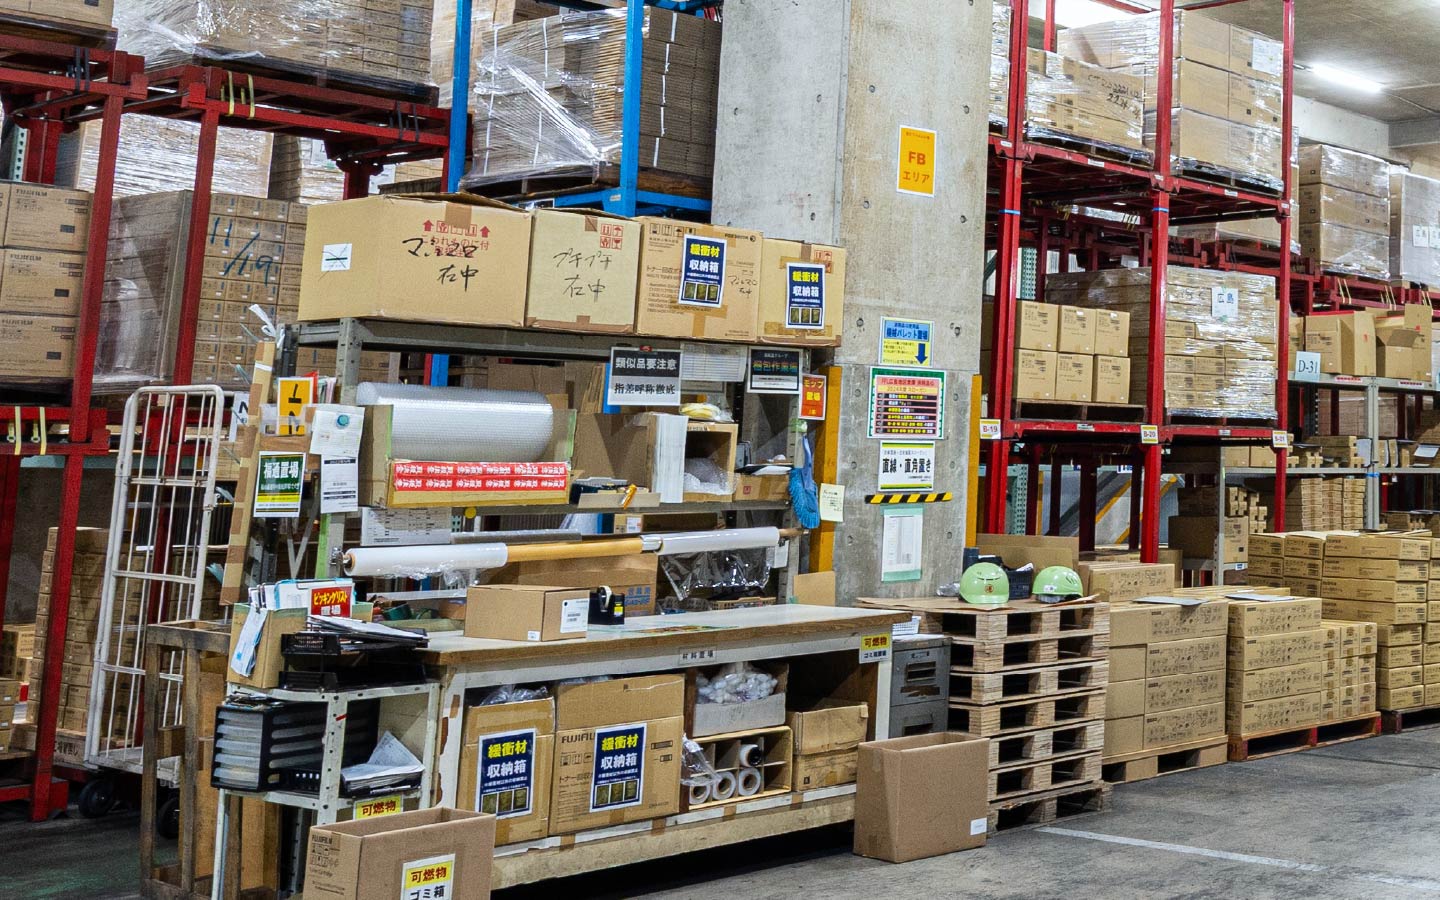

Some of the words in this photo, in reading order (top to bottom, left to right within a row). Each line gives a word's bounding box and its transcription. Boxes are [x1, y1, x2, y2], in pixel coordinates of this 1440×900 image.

[908, 151, 926, 165] FB
[903, 170, 930, 184] エリア
[689, 243, 721, 258] 緩衝材
[688, 259, 720, 273] 収納箱
[792, 285, 820, 298] 収納箱
[615, 357, 678, 371] 類似品要注意
[1298, 360, 1319, 374] D-31
[614, 383, 676, 395] 指差呼称徹底
[982, 424, 998, 433] B-19
[883, 458, 931, 473] 直線・直角置き
[313, 591, 348, 605] ピッキングリスト
[864, 636, 887, 647] 可燃物
[561, 732, 595, 743] FUJIFIL
[601, 733, 639, 751] 緩衝材
[487, 739, 528, 758] 緩衝材
[600, 752, 638, 770] 収納箱
[486, 759, 527, 778] 収納箱
[361, 800, 397, 816] 可燃物
[410, 866, 447, 884] 可燃物
[410, 885, 446, 900] ゴミ箱
